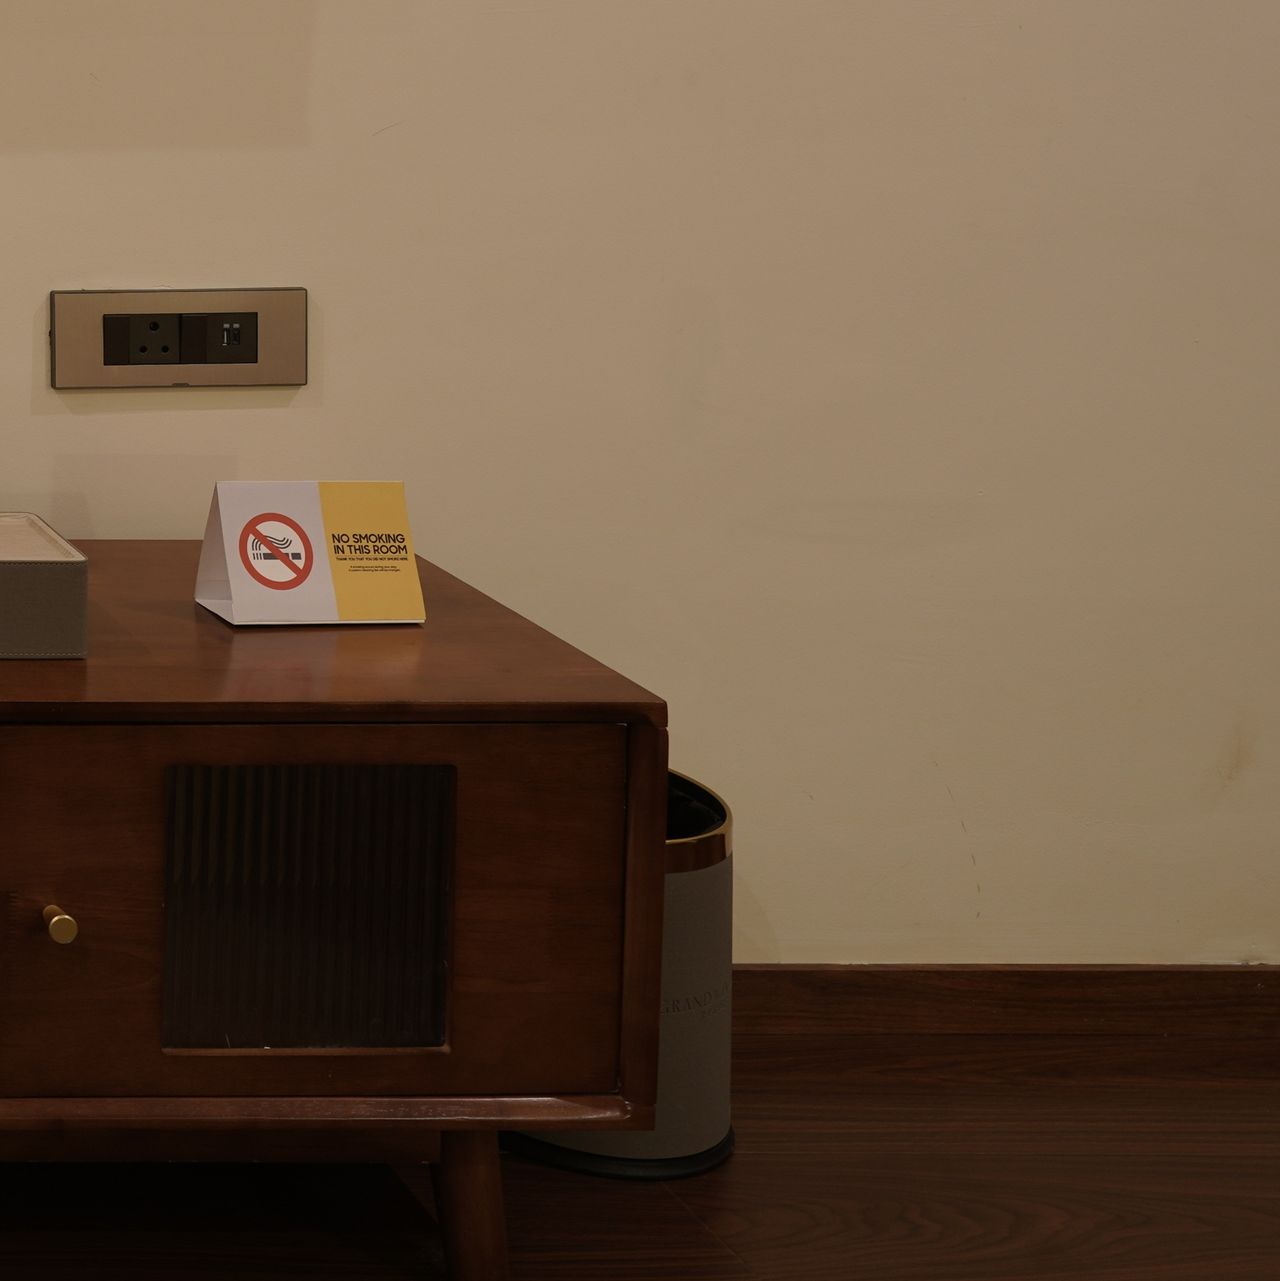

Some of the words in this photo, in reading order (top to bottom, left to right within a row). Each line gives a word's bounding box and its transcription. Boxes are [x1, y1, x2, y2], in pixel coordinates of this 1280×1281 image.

[332, 533, 350, 543] NO
[352, 533, 405, 544] SMOKING
[333, 545, 345, 554] IN
[347, 545, 370, 554] THIS
[373, 545, 407, 554] ROOM
